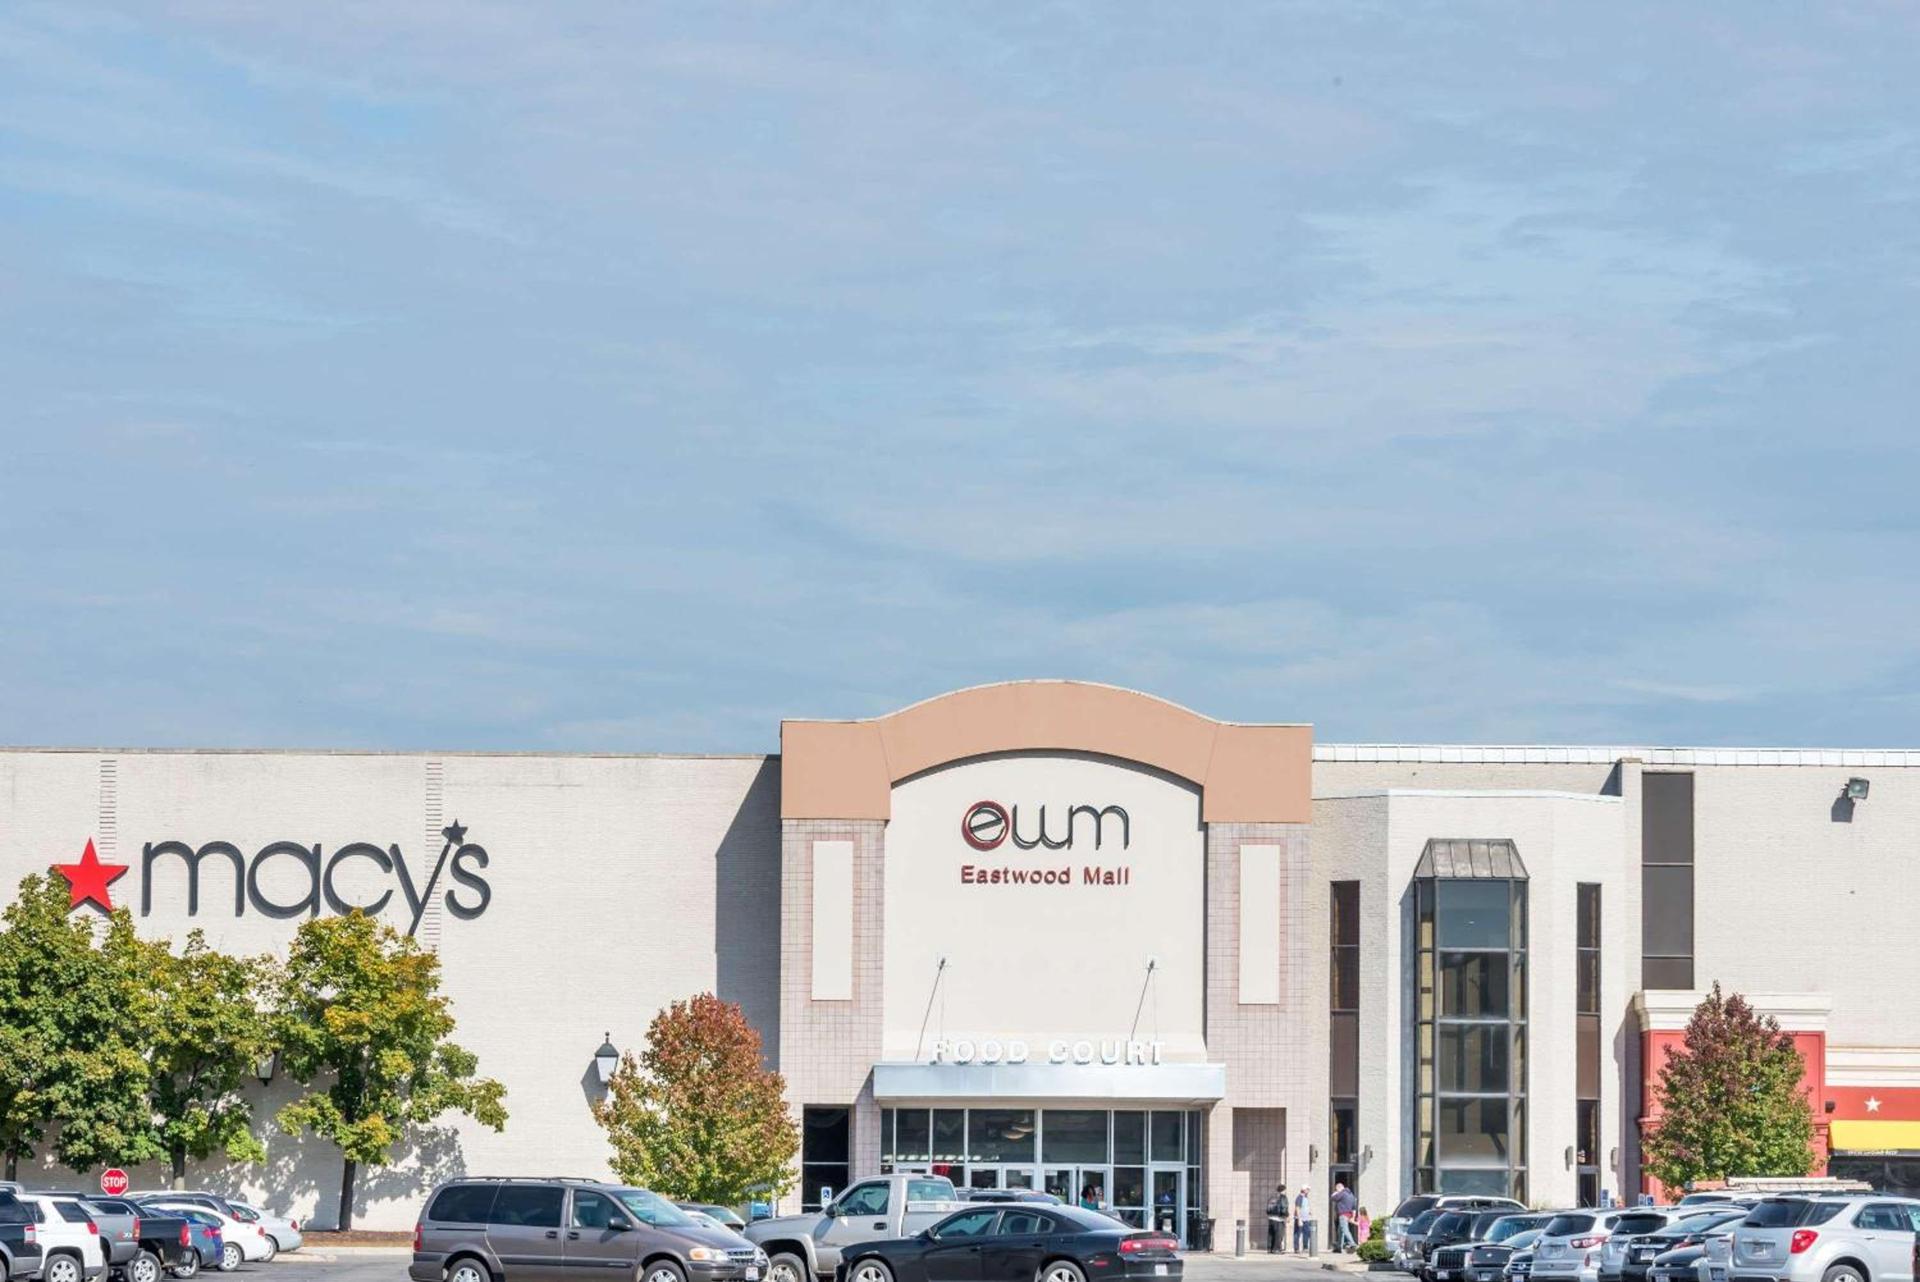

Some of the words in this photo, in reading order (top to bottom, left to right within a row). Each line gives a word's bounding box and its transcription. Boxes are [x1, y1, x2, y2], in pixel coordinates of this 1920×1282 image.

[961, 865, 1071, 885] Eastwood
[1083, 866, 1129, 885] Mall
[929, 1039, 1029, 1065] FOOD
[1048, 1040, 1165, 1065] COURT
[103, 1176, 126, 1188] STOP
